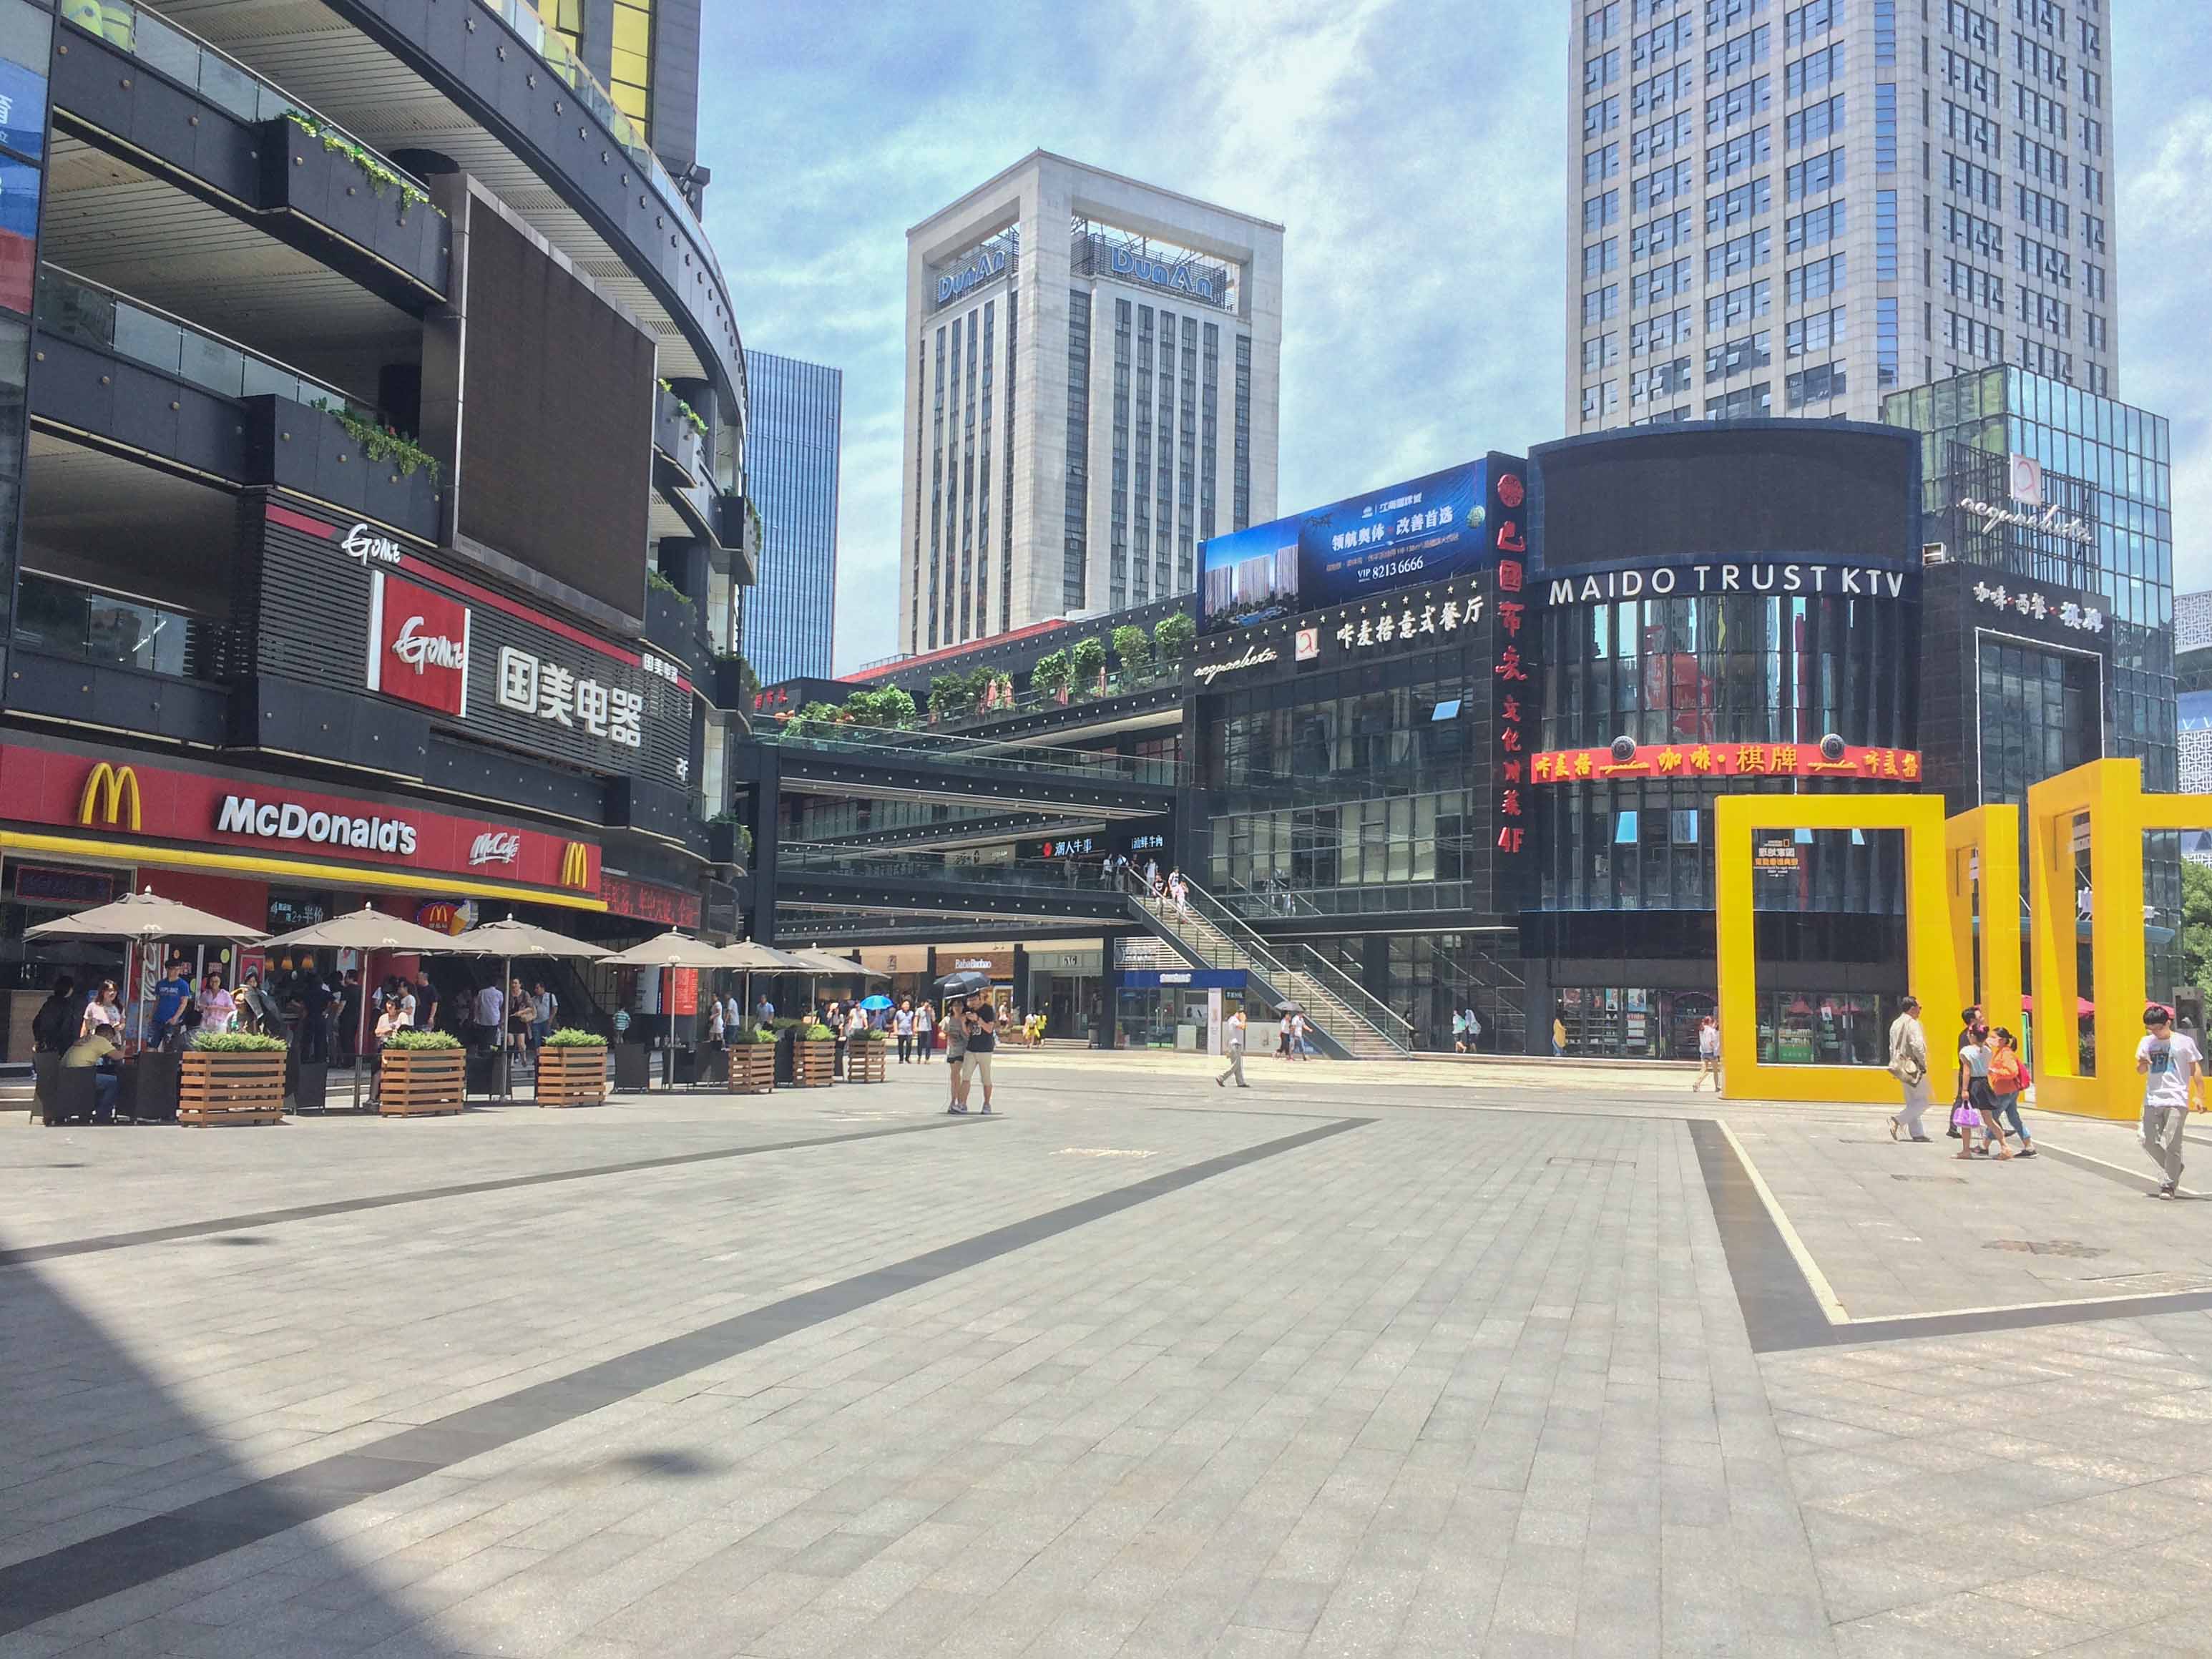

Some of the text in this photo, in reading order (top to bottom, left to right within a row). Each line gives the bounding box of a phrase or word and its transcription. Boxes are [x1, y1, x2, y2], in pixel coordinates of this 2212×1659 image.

[1358, 569, 1371, 579] VIP
[1549, 564, 1904, 606] MAIDO TRUST KTV
[496, 645, 643, 748] 国美电器
[217, 795, 417, 855] McDonald's
[1497, 826, 1525, 853] 4F
